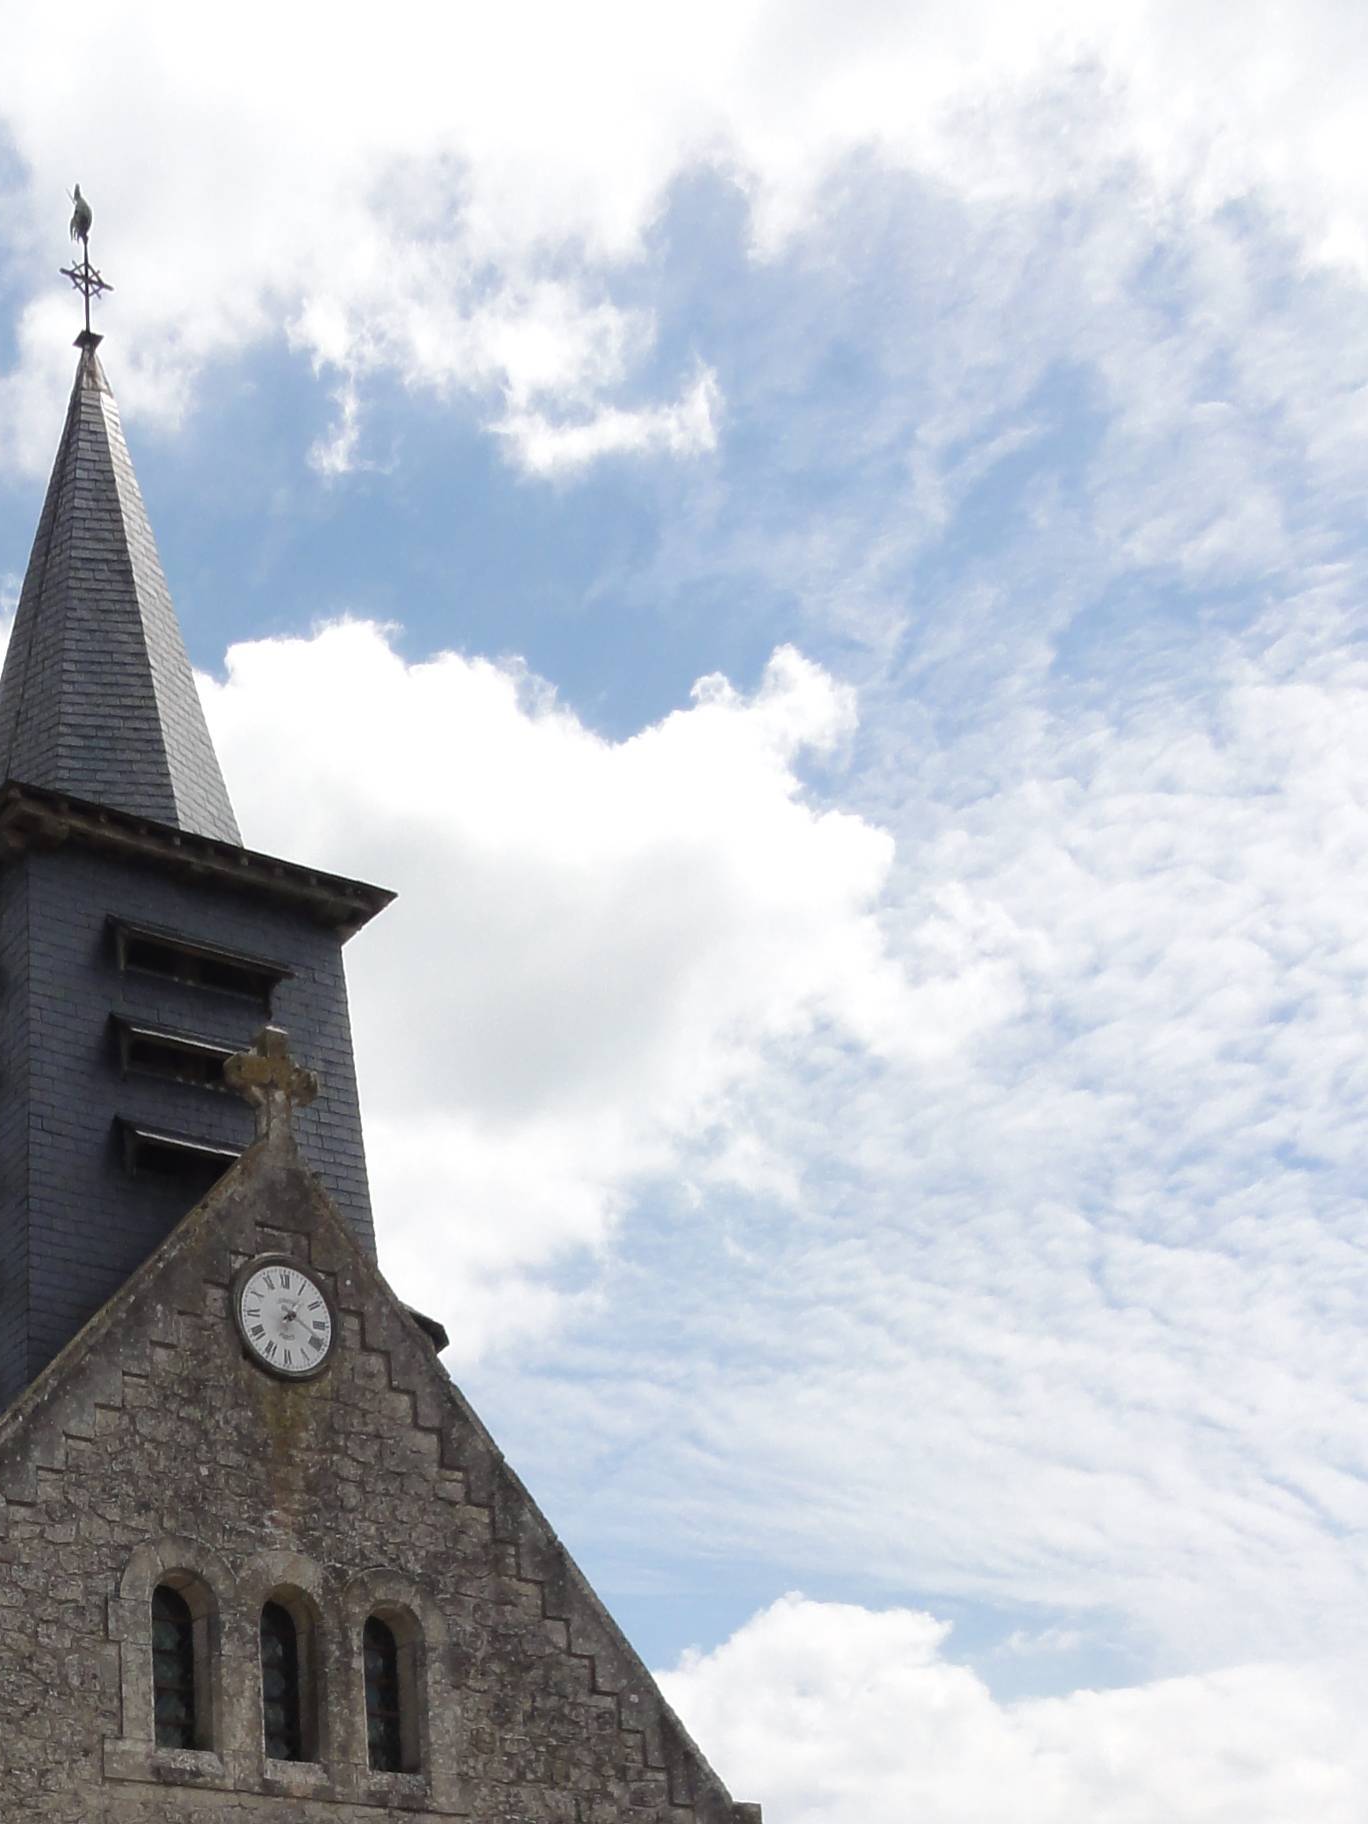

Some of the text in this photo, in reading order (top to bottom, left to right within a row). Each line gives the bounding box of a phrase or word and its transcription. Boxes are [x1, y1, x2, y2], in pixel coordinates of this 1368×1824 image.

[279, 1273, 290, 1290] XII
[298, 1280, 307, 1296] I
[307, 1301, 321, 1311] II
[312, 1320, 325, 1331] III
